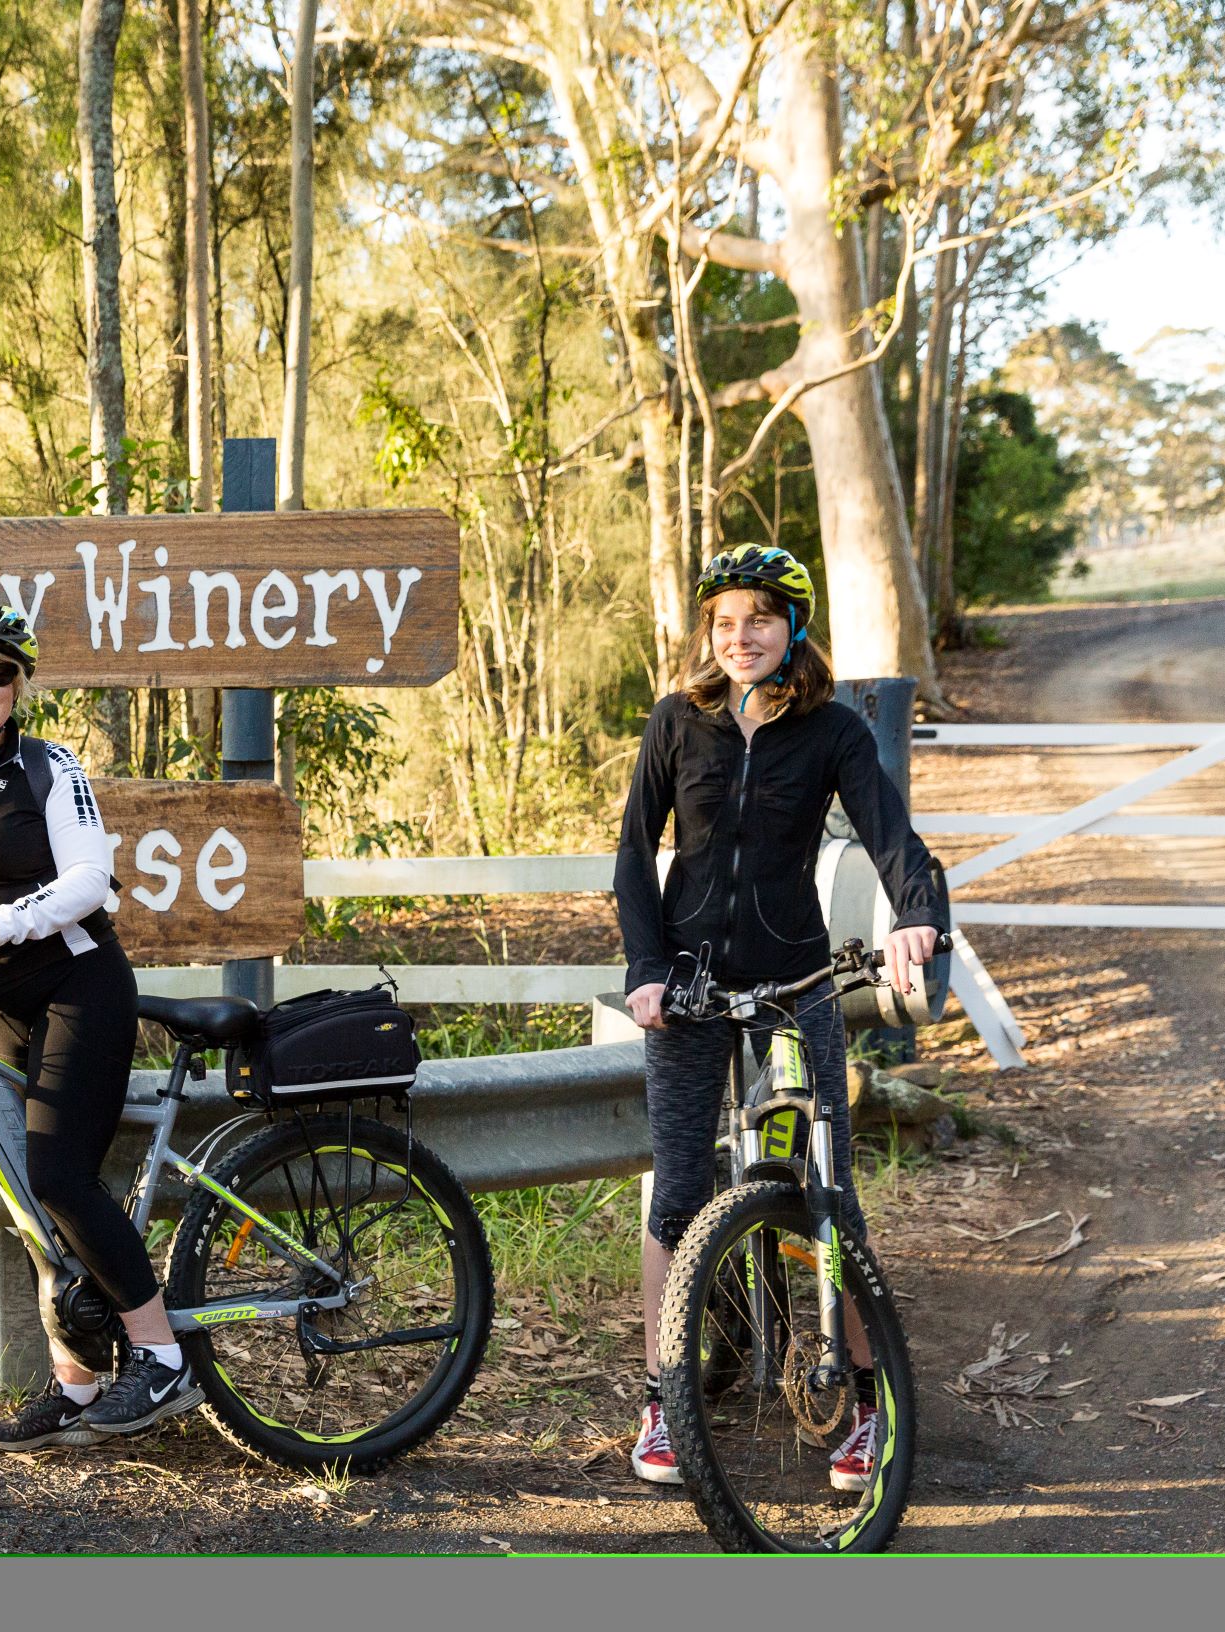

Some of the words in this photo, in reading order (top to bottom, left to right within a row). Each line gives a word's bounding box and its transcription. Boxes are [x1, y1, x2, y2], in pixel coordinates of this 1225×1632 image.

[76, 540, 423, 673] Winery
[288, 1057, 403, 1080] TOPEAK
[262, 1221, 318, 1263] FATHOM
[201, 1309, 257, 1322] GIANT
